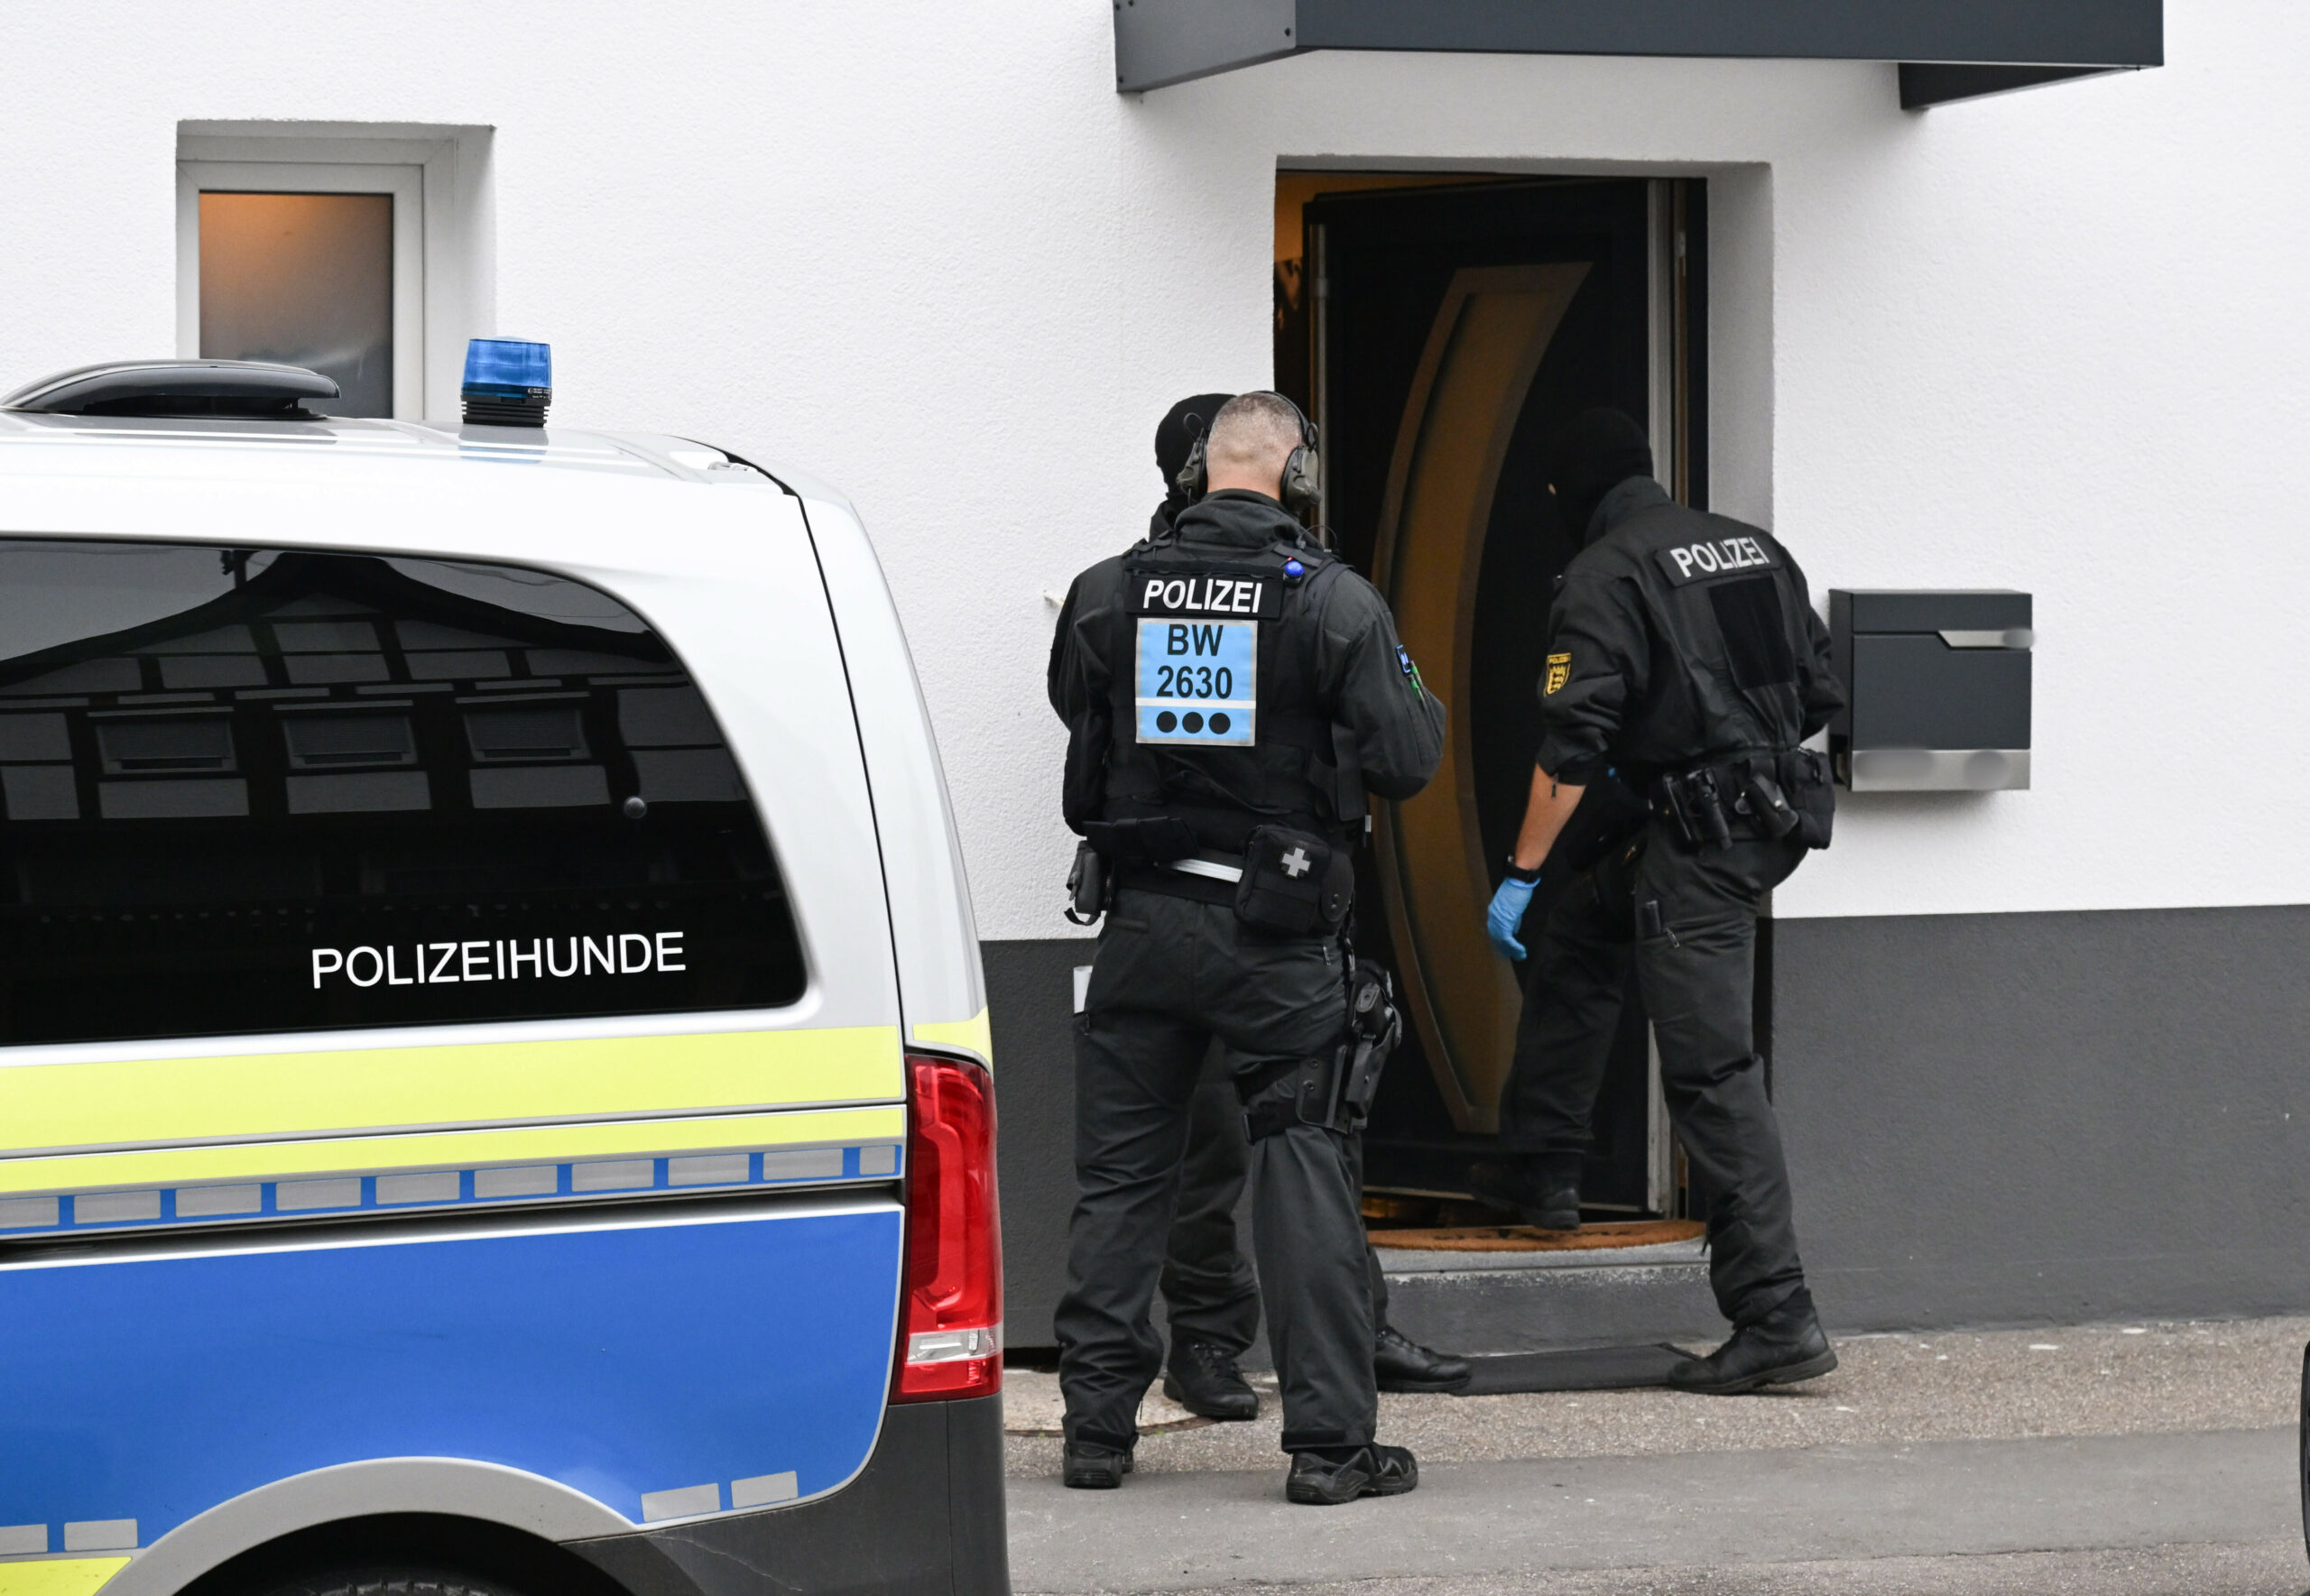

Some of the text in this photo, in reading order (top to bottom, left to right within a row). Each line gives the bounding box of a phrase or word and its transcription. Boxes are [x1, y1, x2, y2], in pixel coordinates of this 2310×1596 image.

[1669, 536, 1769, 578] POLIZEI
[1143, 578, 1262, 613] POLIZEI
[1168, 623, 1224, 657] BW
[1156, 665, 1233, 699] 2630
[312, 931, 687, 990] POLIZEIHUNDE
